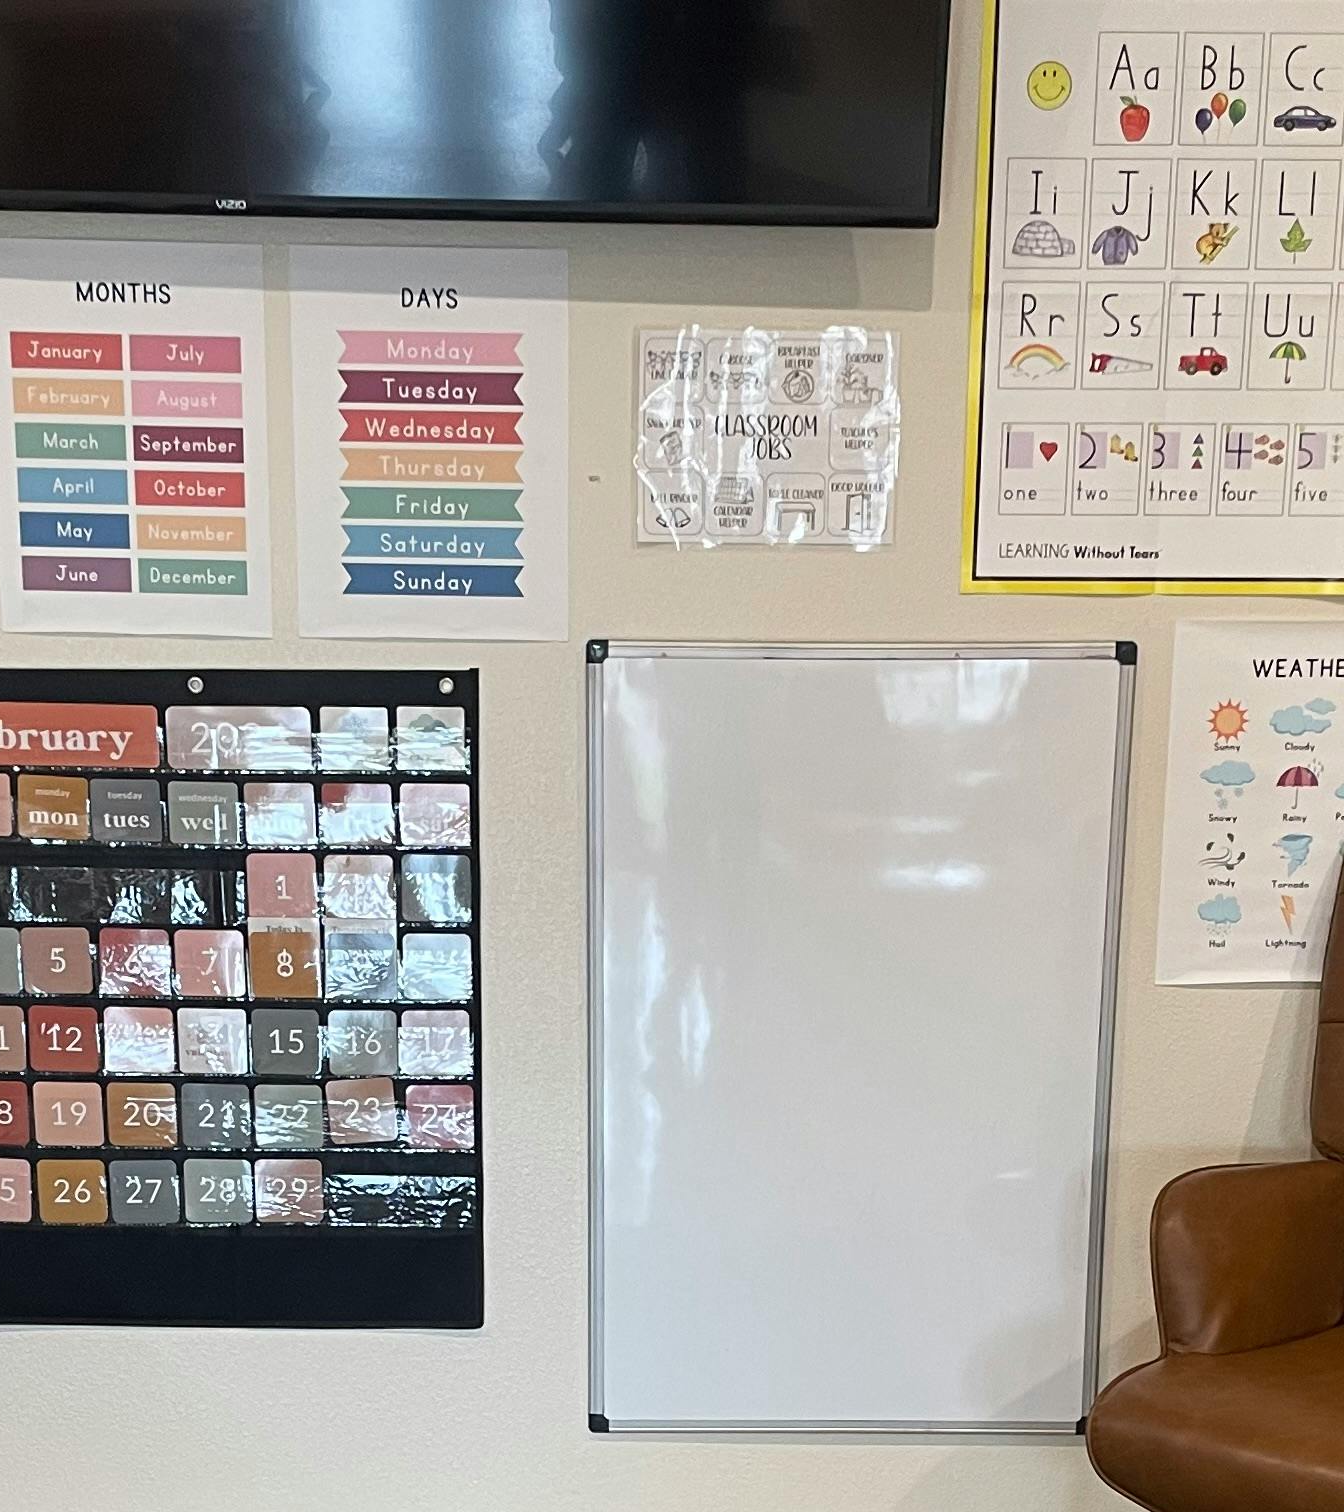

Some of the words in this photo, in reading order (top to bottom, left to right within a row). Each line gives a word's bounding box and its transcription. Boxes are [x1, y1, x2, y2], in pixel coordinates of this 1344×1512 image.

[1109, 44, 1159, 90] Aa
[1201, 45, 1244, 91] Bb
[1286, 45, 1325, 91] Cc
[215, 199, 247, 209] VIZIO
[1030, 170, 1057, 214] Ii
[1112, 170, 1154, 242] Jj
[1191, 170, 1239, 216] Kk
[1278, 170, 1317, 217] Ll
[76, 281, 172, 304] MONTHS
[401, 287, 458, 309] DAYS
[1019, 293, 1065, 337] Rr
[1101, 293, 1142, 337] Ss
[1182, 292, 1223, 337] Tt
[1263, 293, 1315, 338] Uu
[27, 341, 103, 363] January
[166, 343, 205, 365] July
[387, 339, 474, 364] Monday
[27, 386, 110, 408] February
[156, 390, 217, 411] August
[382, 378, 478, 404] Tuesday
[365, 417, 495, 443] Wednesday
[714, 414, 818, 437] CLASSROOM
[43, 431, 99, 450] March
[140, 434, 237, 455] September
[750, 438, 792, 460] JOBS
[1004, 431, 1010, 469] 1
[1078, 431, 1097, 469] 2
[1151, 432, 1166, 469] 3
[1224, 431, 1253, 470] 4
[1296, 432, 1317, 470] 5
[379, 456, 485, 481] Thursday
[52, 478, 95, 495] April
[154, 479, 226, 498] October
[1003, 488, 1037, 501] one
[1077, 480, 1109, 501] two
[1149, 480, 1198, 501] three
[1221, 480, 1258, 502] four
[1294, 481, 1328, 502] five
[396, 495, 470, 519] Friday
[56, 521, 93, 542] May
[148, 524, 234, 542] November
[380, 533, 486, 558] Saturday
[998, 544, 1069, 560] LEARNING
[1074, 545, 1125, 560] Without
[1129, 546, 1160, 560] Tears
[56, 565, 98, 582] June
[150, 567, 237, 585] December
[393, 571, 473, 594] Sunday
[1213, 742, 1241, 752] Sunny
[1284, 741, 1316, 752] Cloudy
[28, 808, 79, 826] mon
[104, 812, 150, 829] tues
[1208, 813, 1238, 823] Snowy
[1282, 813, 1307, 823] Rainy
[275, 874, 294, 900] 1
[1207, 878, 1235, 888] Windy
[1271, 880, 1310, 888] Tornado
[1208, 940, 1226, 948] Hail
[1264, 939, 1306, 949] Lightning
[50, 947, 67, 973] 5
[277, 951, 294, 978] 8
[46, 1027, 83, 1052] 12
[269, 1029, 304, 1054] 15
[51, 1101, 87, 1126] 19
[123, 1102, 161, 1127] 20
[344, 1098, 381, 1123] 23
[54, 1179, 91, 1203] 26
[126, 1180, 163, 1204] 27
[200, 1178, 236, 1202] 28
[270, 1178, 308, 1202] 29
